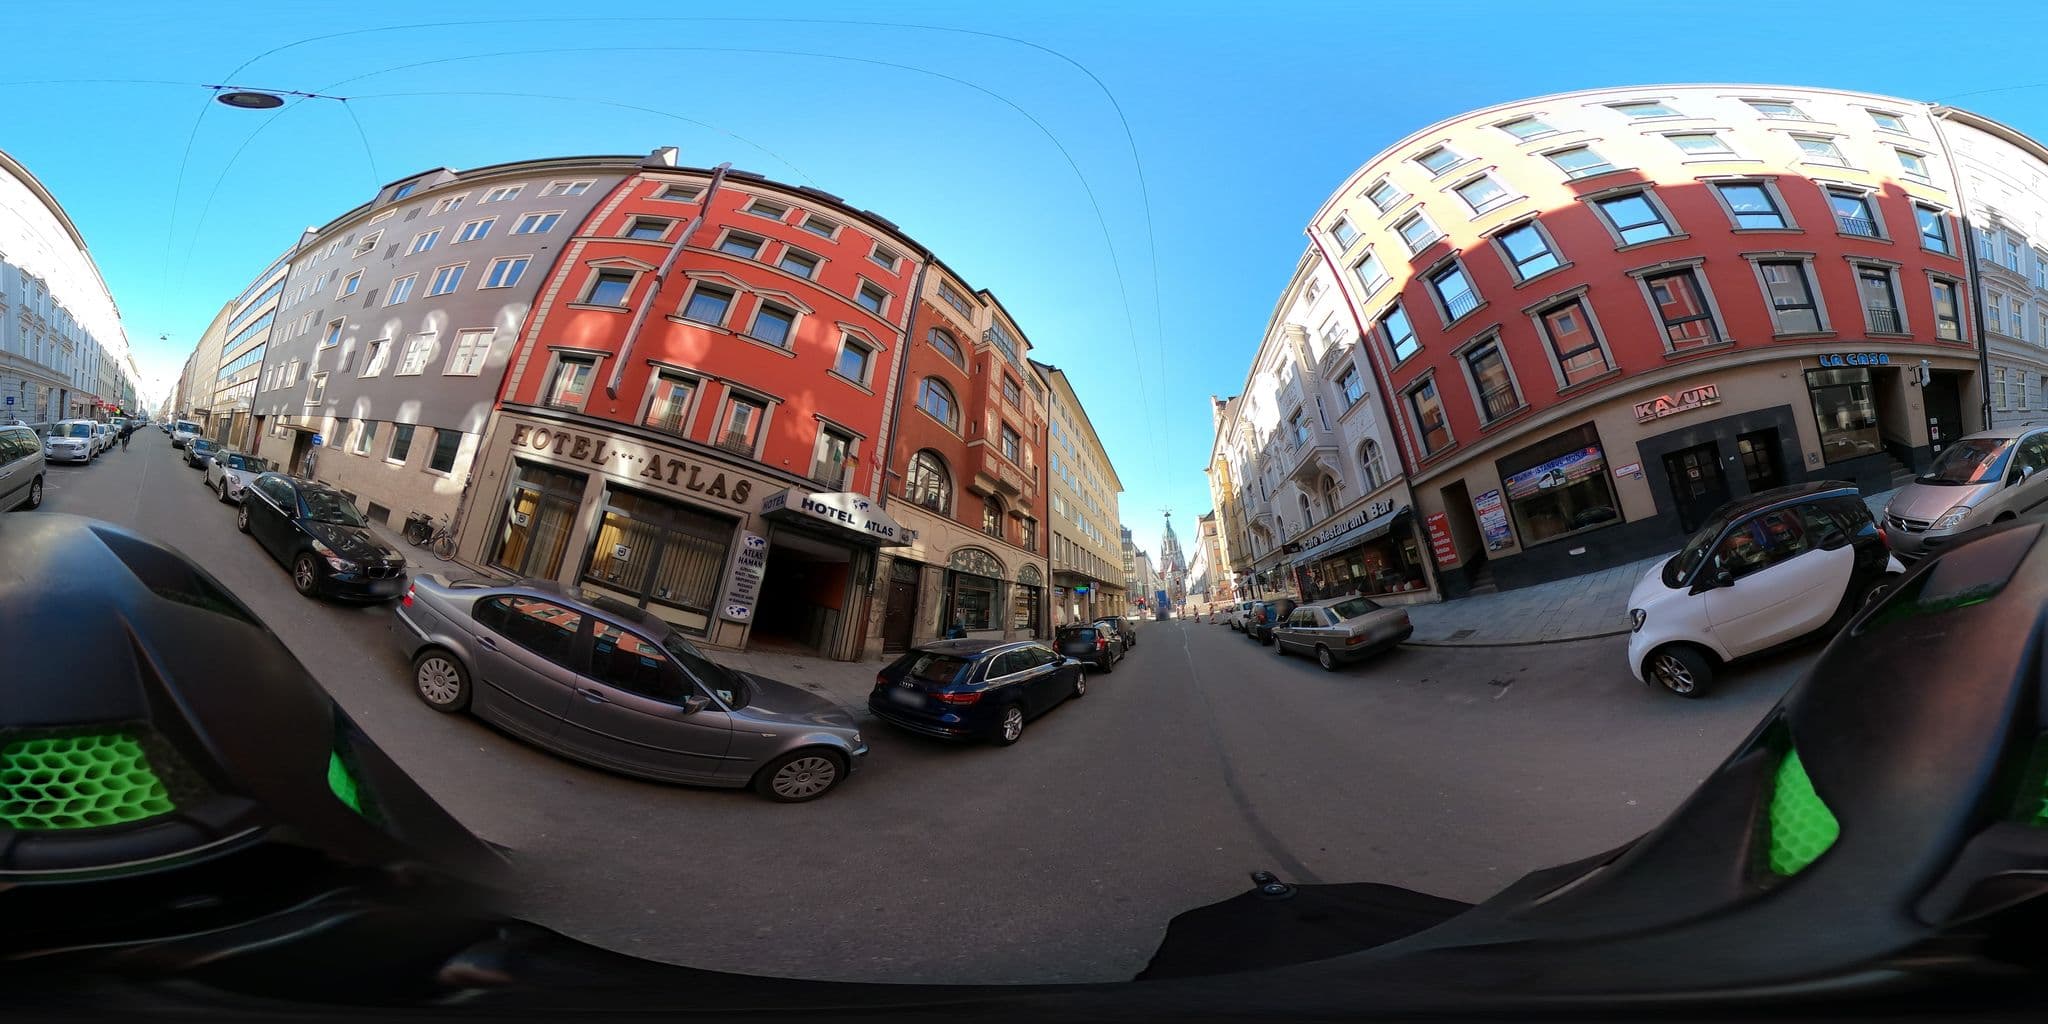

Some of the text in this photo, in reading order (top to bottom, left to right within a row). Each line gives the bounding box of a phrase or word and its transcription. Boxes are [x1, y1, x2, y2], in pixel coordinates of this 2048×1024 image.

[1819, 352, 1889, 367] LA CASA
[1637, 387, 1716, 417] KAVUN
[510, 423, 753, 504] HOTEL ATLAS
[801, 497, 894, 537] HOTEL ATLAS
[1319, 510, 1369, 543] Restaurant
[1370, 498, 1394, 519] Bar
[738, 557, 764, 569] HAMAM
[743, 548, 764, 560] ATLAS
